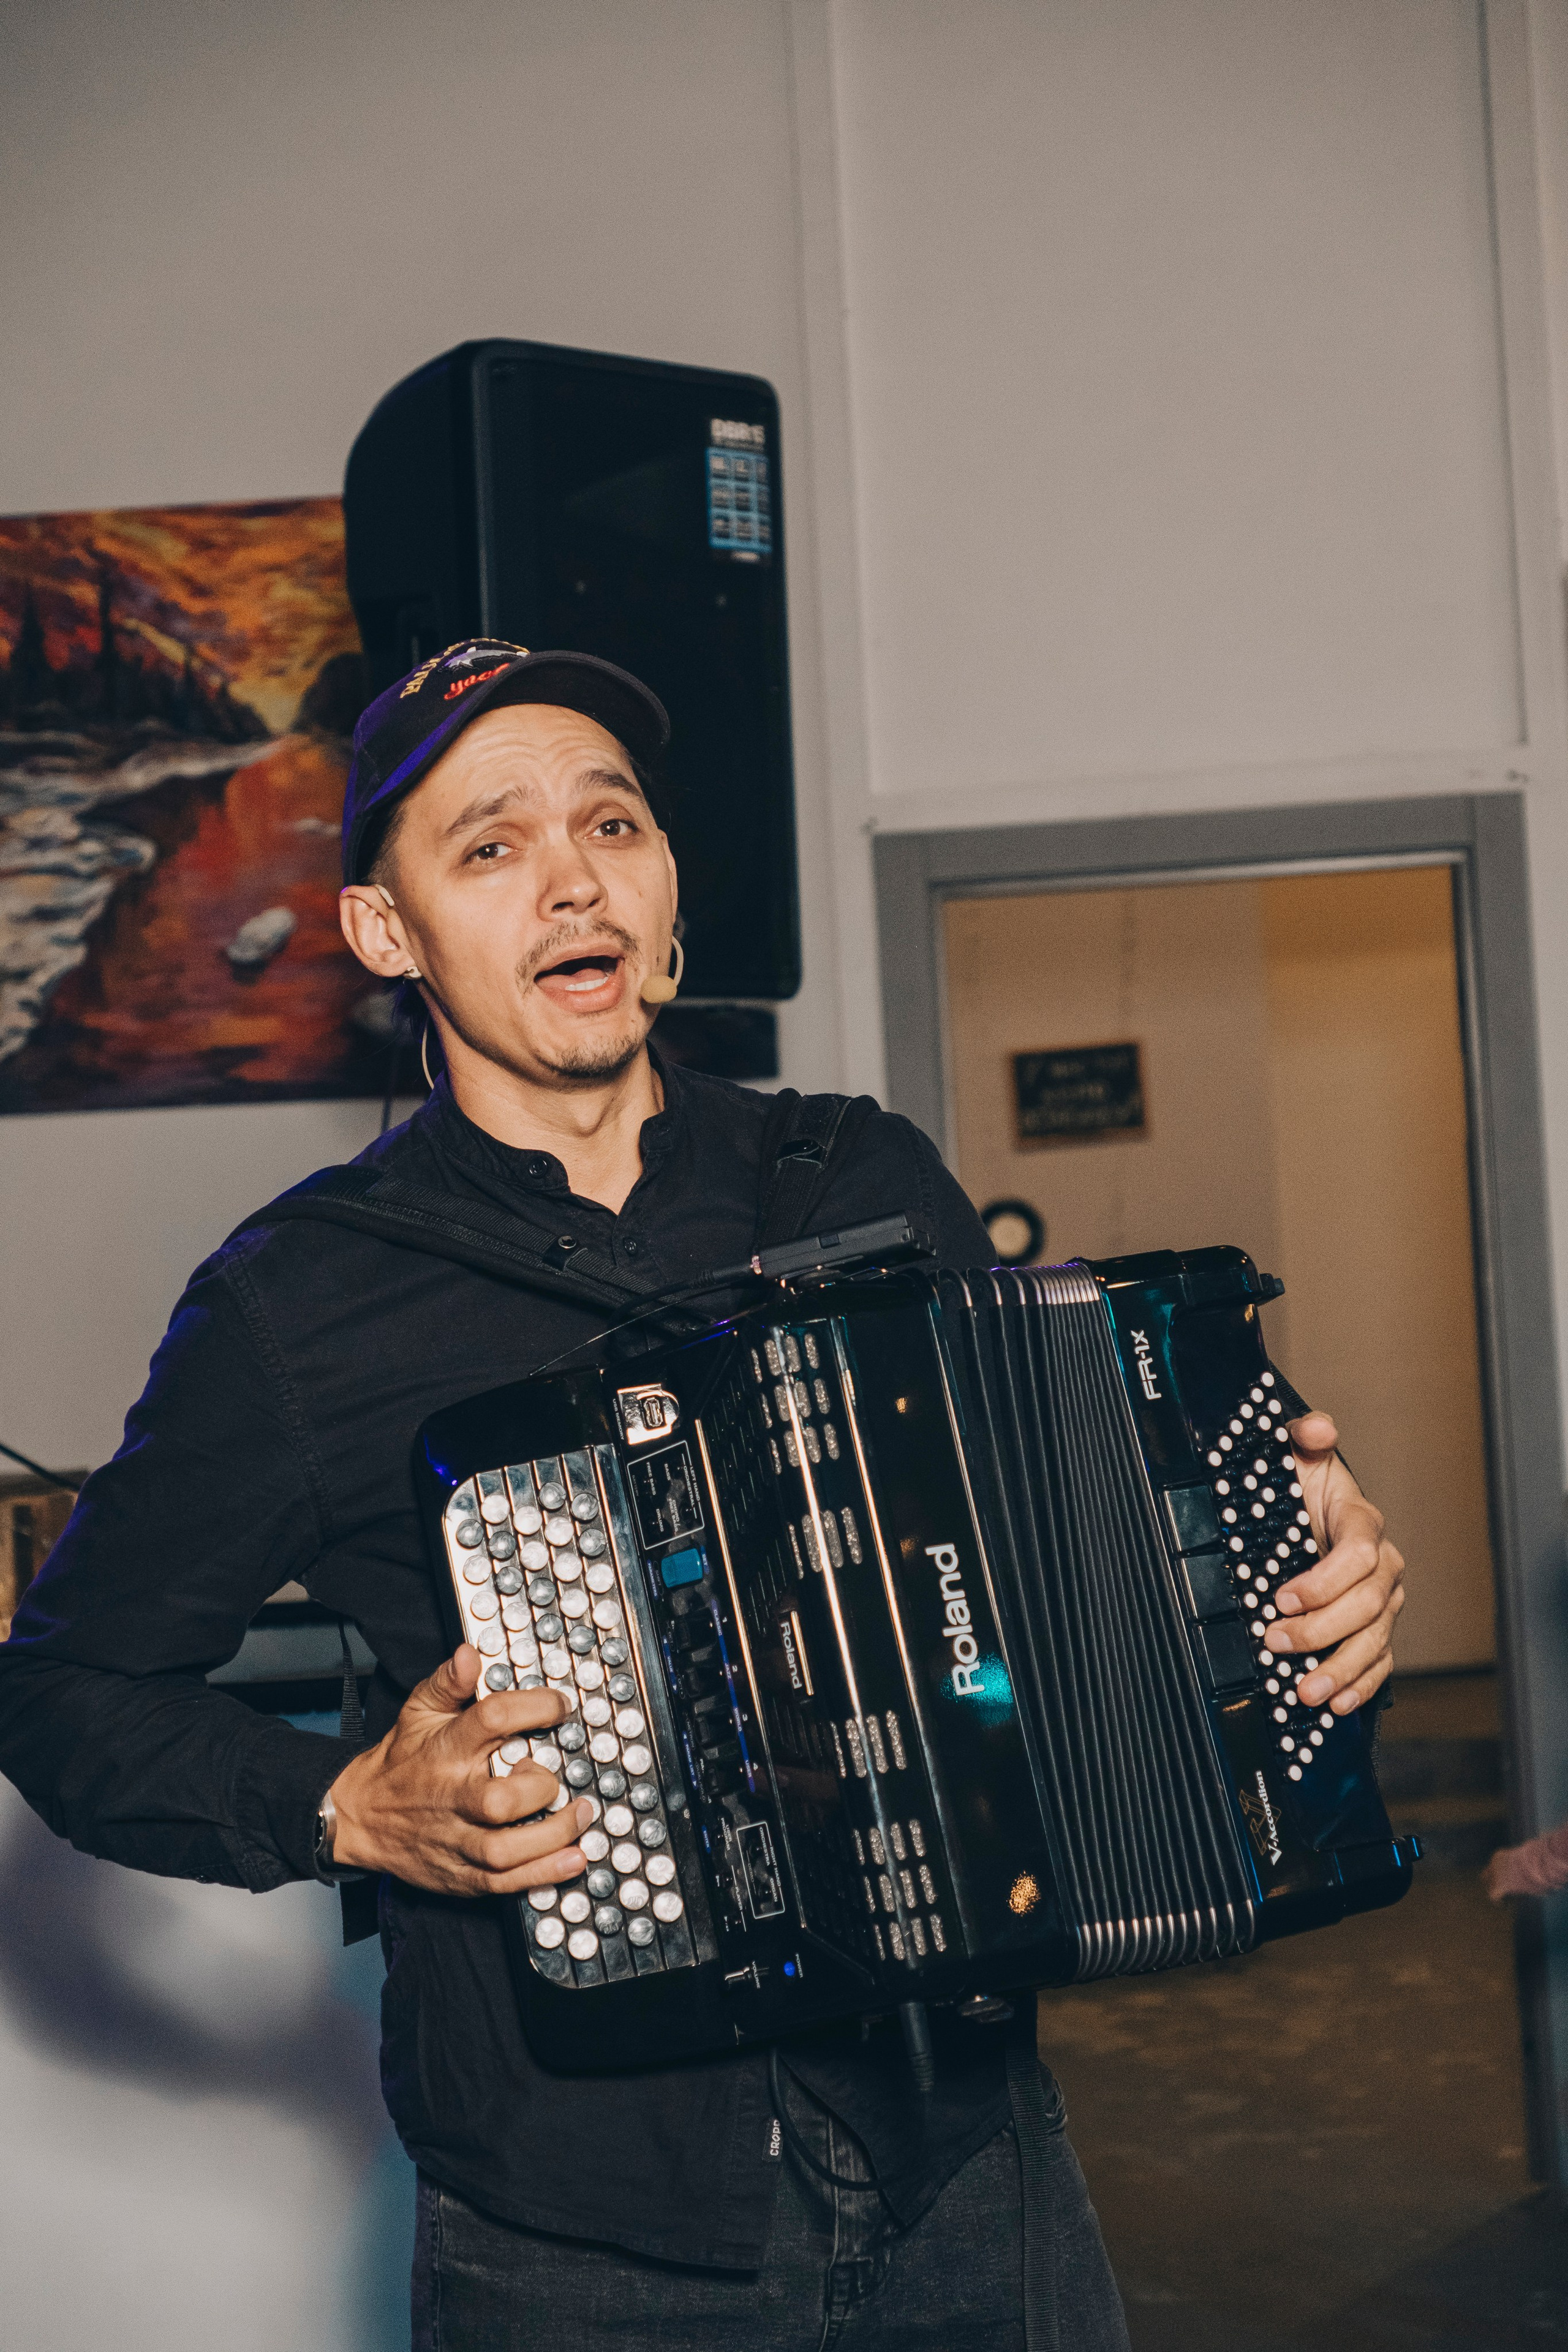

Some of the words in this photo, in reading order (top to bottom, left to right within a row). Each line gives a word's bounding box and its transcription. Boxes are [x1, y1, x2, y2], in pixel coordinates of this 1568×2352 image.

[1131, 1330, 1162, 1400] FR-1x
[683, 1466, 695, 1507] ORCHESTRAL
[647, 1563, 657, 1596] PARAMETERS
[713, 1609, 722, 1636] CLASSIC
[925, 1543, 985, 1695] Roland
[731, 1664, 737, 1673] 2
[780, 1622, 802, 1689] Roland
[733, 1708, 742, 1732] WORLD
[742, 1713, 748, 1722] 3
[752, 1762, 758, 1771] 4
[720, 1817, 731, 1850] PROGRAM
[759, 1827, 771, 1866] ORCHESTRA
[769, 1847, 777, 1866] RIGHT
[734, 1887, 743, 1910] PLAYER
[769, 1878, 778, 1902] ORGAN
[752, 1961, 760, 1989] VOLUME
